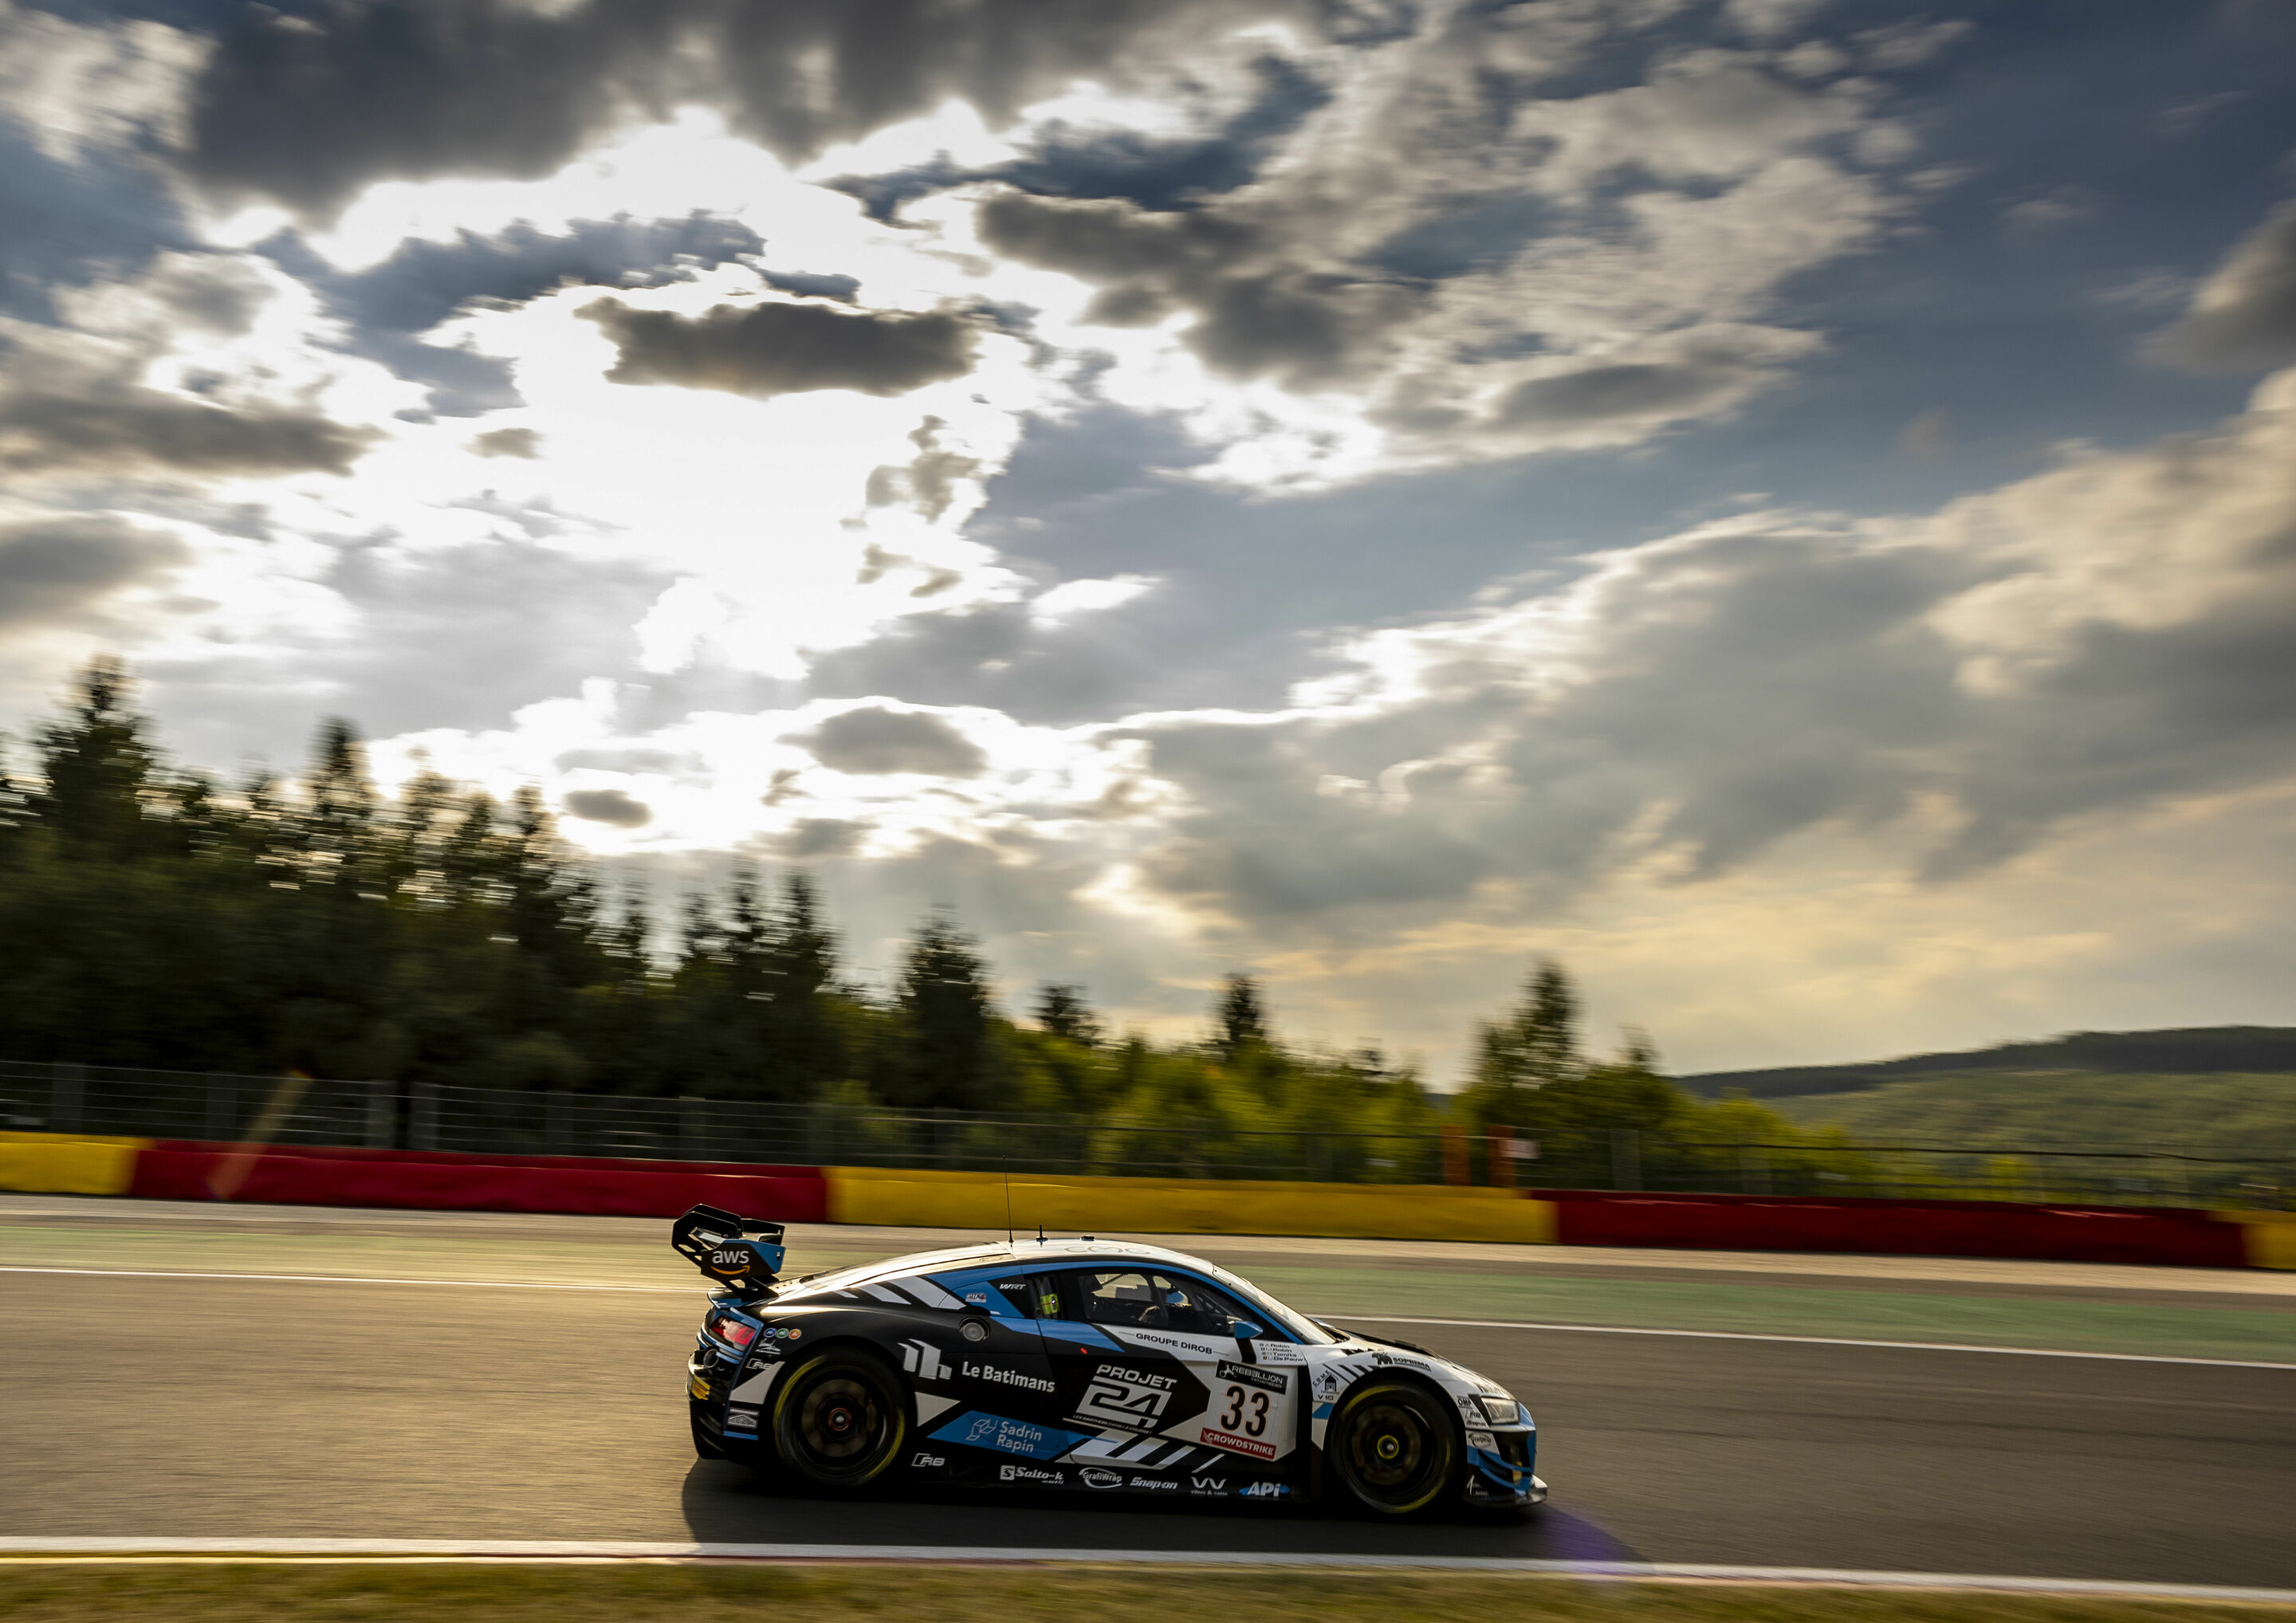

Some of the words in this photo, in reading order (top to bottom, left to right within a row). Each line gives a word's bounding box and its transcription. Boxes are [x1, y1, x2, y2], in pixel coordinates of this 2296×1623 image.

[712, 1251, 749, 1263] aws
[1136, 1333, 1178, 1347] GROUPE
[1181, 1342, 1213, 1354] DIROB
[1393, 1358, 1429, 1369] SOPREMA
[961, 1361, 981, 1377] Le
[982, 1365, 1056, 1393] Batimans
[1096, 1364, 1177, 1389] PROJET
[1232, 1366, 1283, 1385] REBELLION
[1086, 1381, 1164, 1426] 24
[1221, 1385, 1269, 1437] 33
[999, 1421, 1043, 1441] Sadrin
[997, 1435, 1034, 1452] Rapin
[1208, 1432, 1274, 1456] CROWDSTRIKE
[916, 1454, 946, 1467] R8
[1015, 1467, 1064, 1480] Saito-k
[1083, 1472, 1122, 1483] GrafiWrap
[1130, 1476, 1178, 1489] Snap-on
